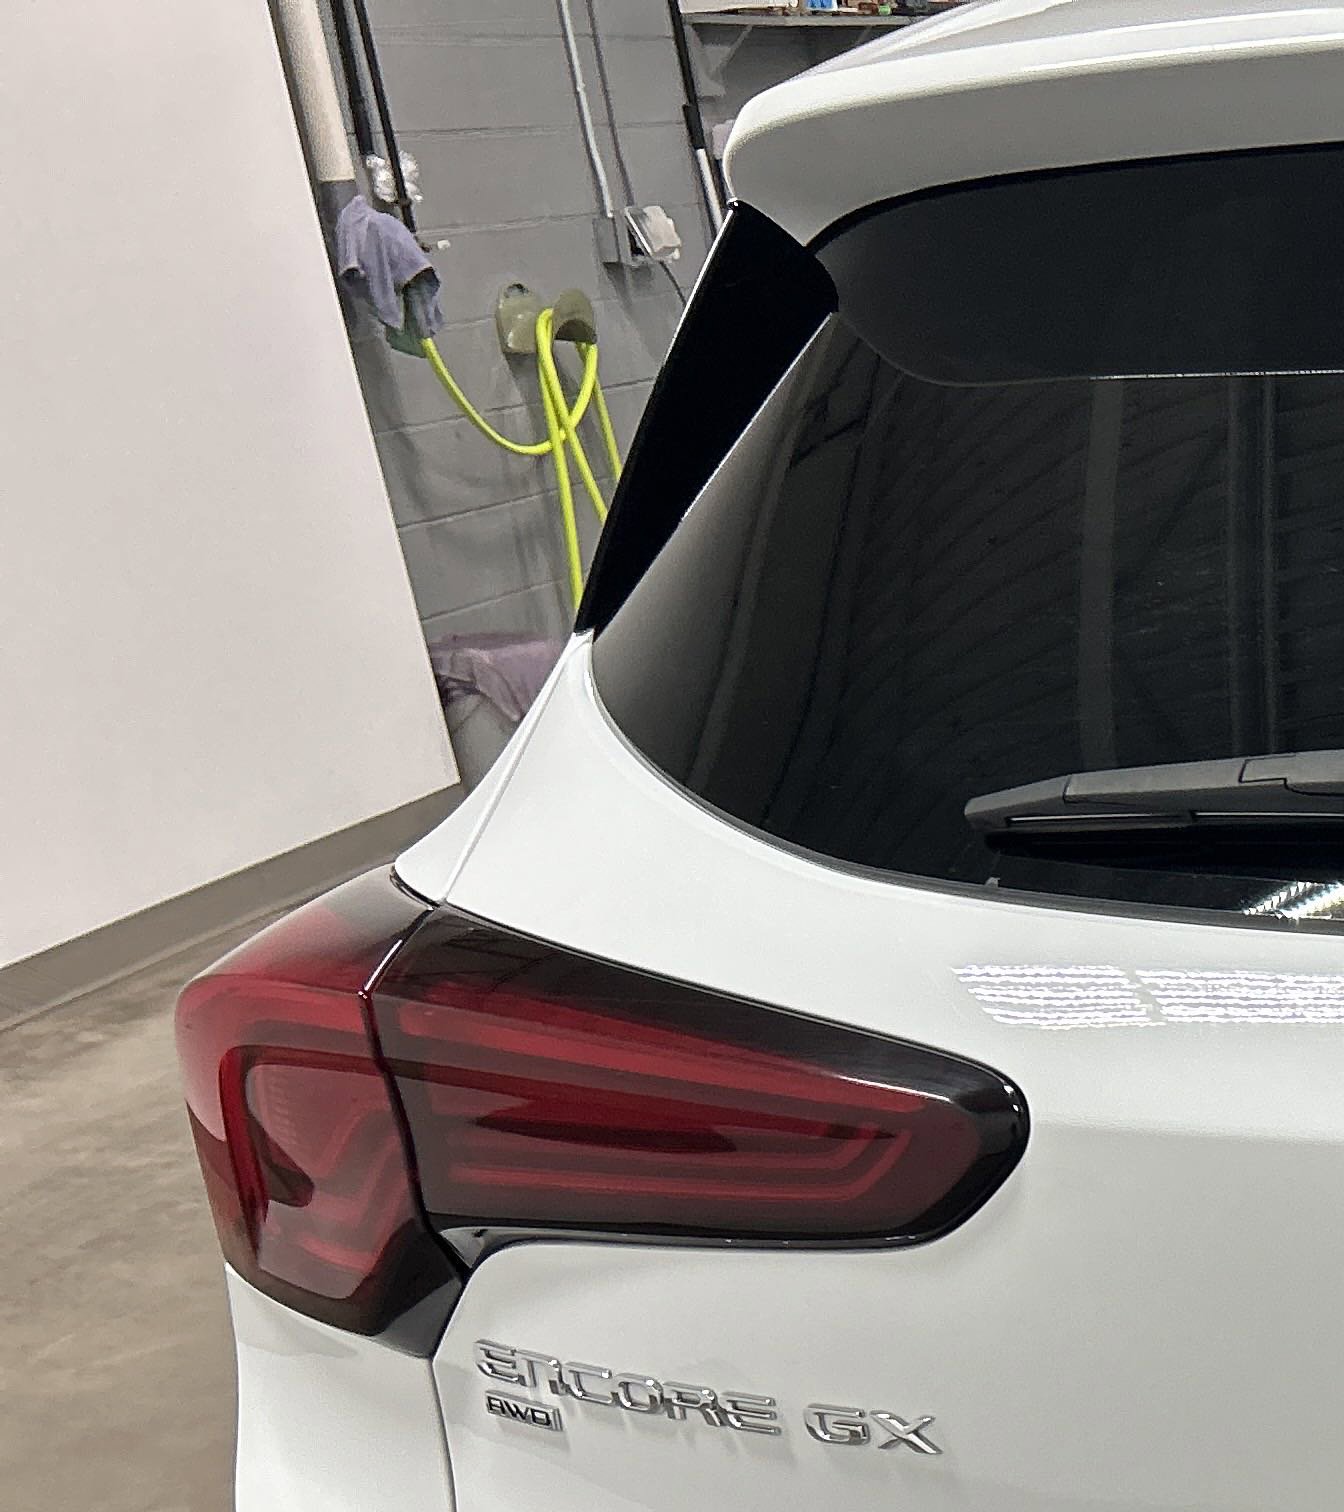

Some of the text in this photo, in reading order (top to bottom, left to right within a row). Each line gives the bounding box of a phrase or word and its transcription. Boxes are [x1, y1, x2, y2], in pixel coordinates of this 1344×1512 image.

[473, 1338, 944, 1455] ENCORE GX
[486, 1393, 553, 1429] AWD
